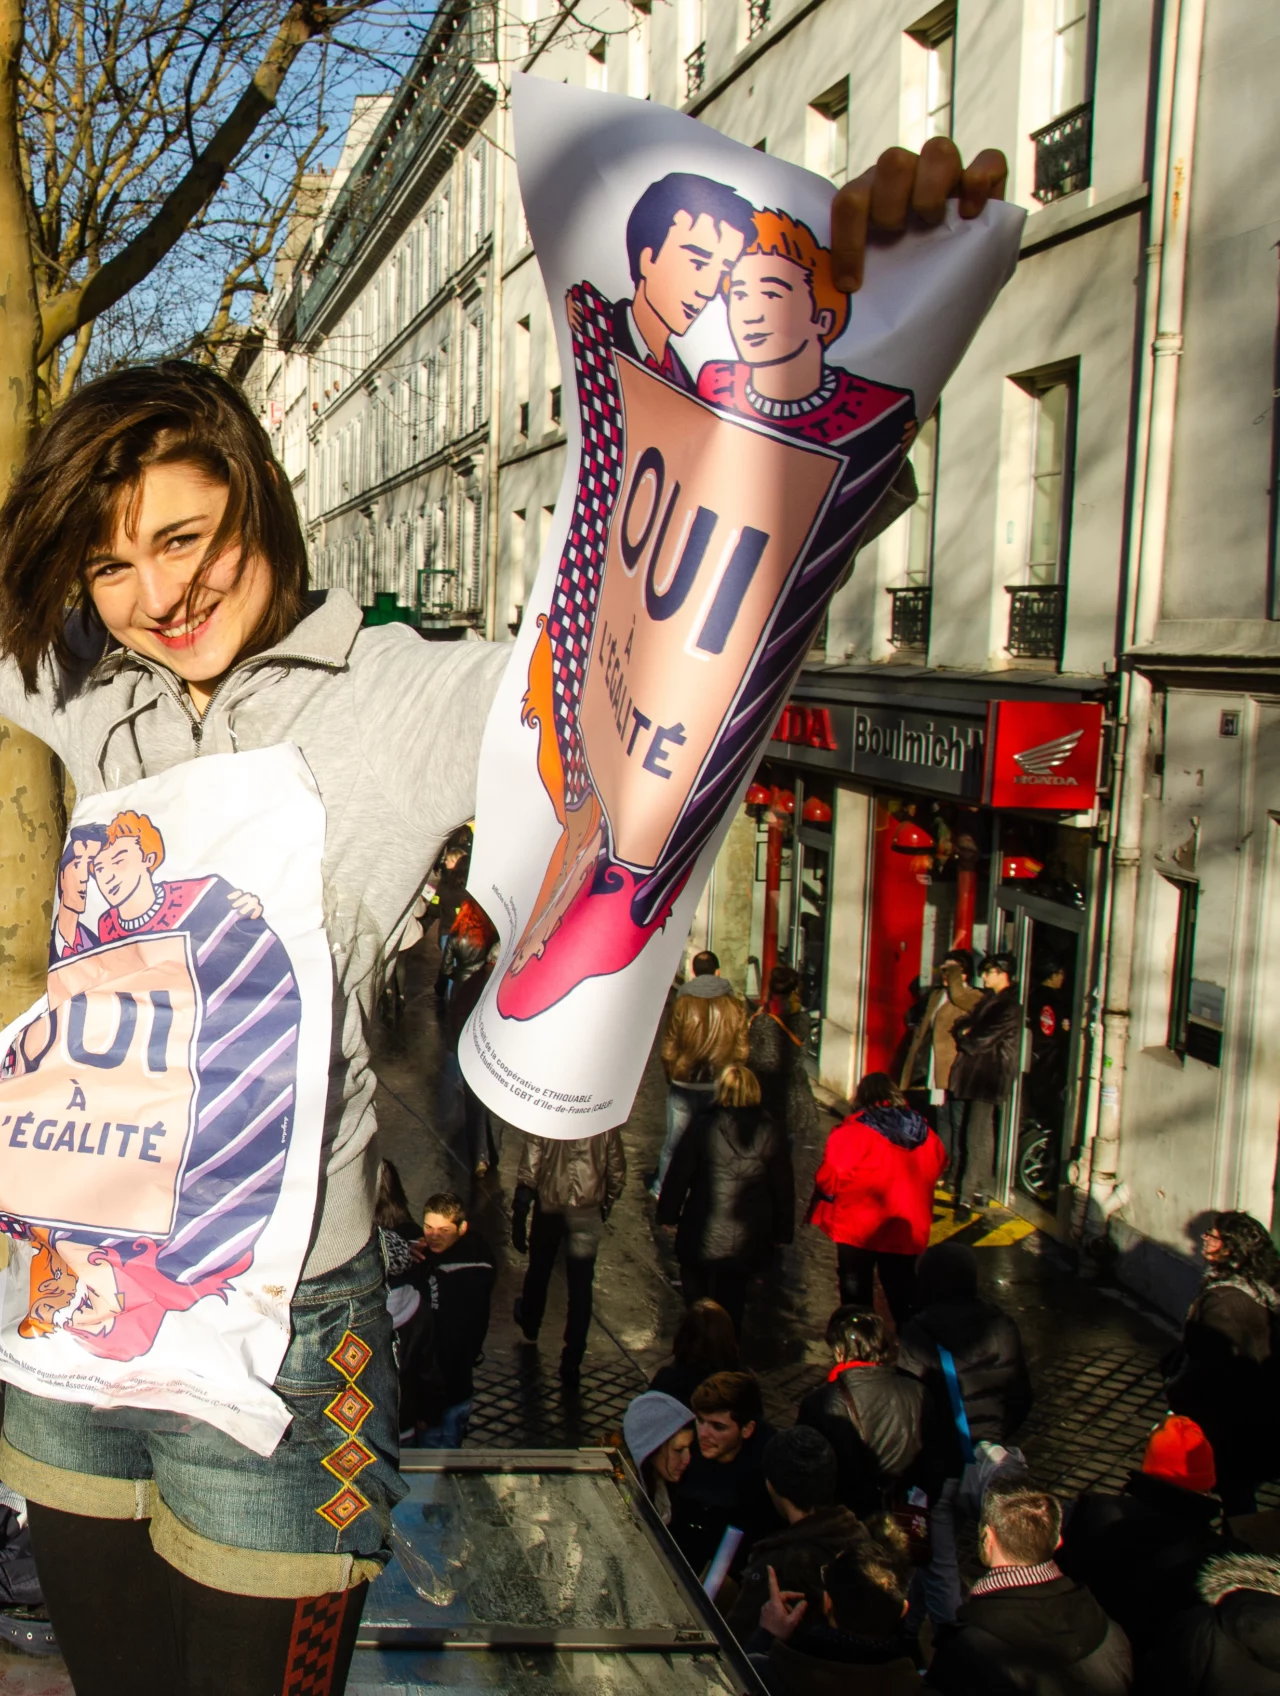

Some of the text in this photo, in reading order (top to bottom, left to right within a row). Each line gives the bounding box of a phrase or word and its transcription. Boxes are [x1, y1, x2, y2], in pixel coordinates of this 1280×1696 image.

[619, 447, 770, 656] OUI
[1013, 775, 1079, 786] HONDA
[65, 1078, 87, 1111] À
[496, 1058, 541, 1094] coopérative
[542, 1088, 593, 1103] ETHIQUABLE
[509, 1084, 534, 1102] LGBT
